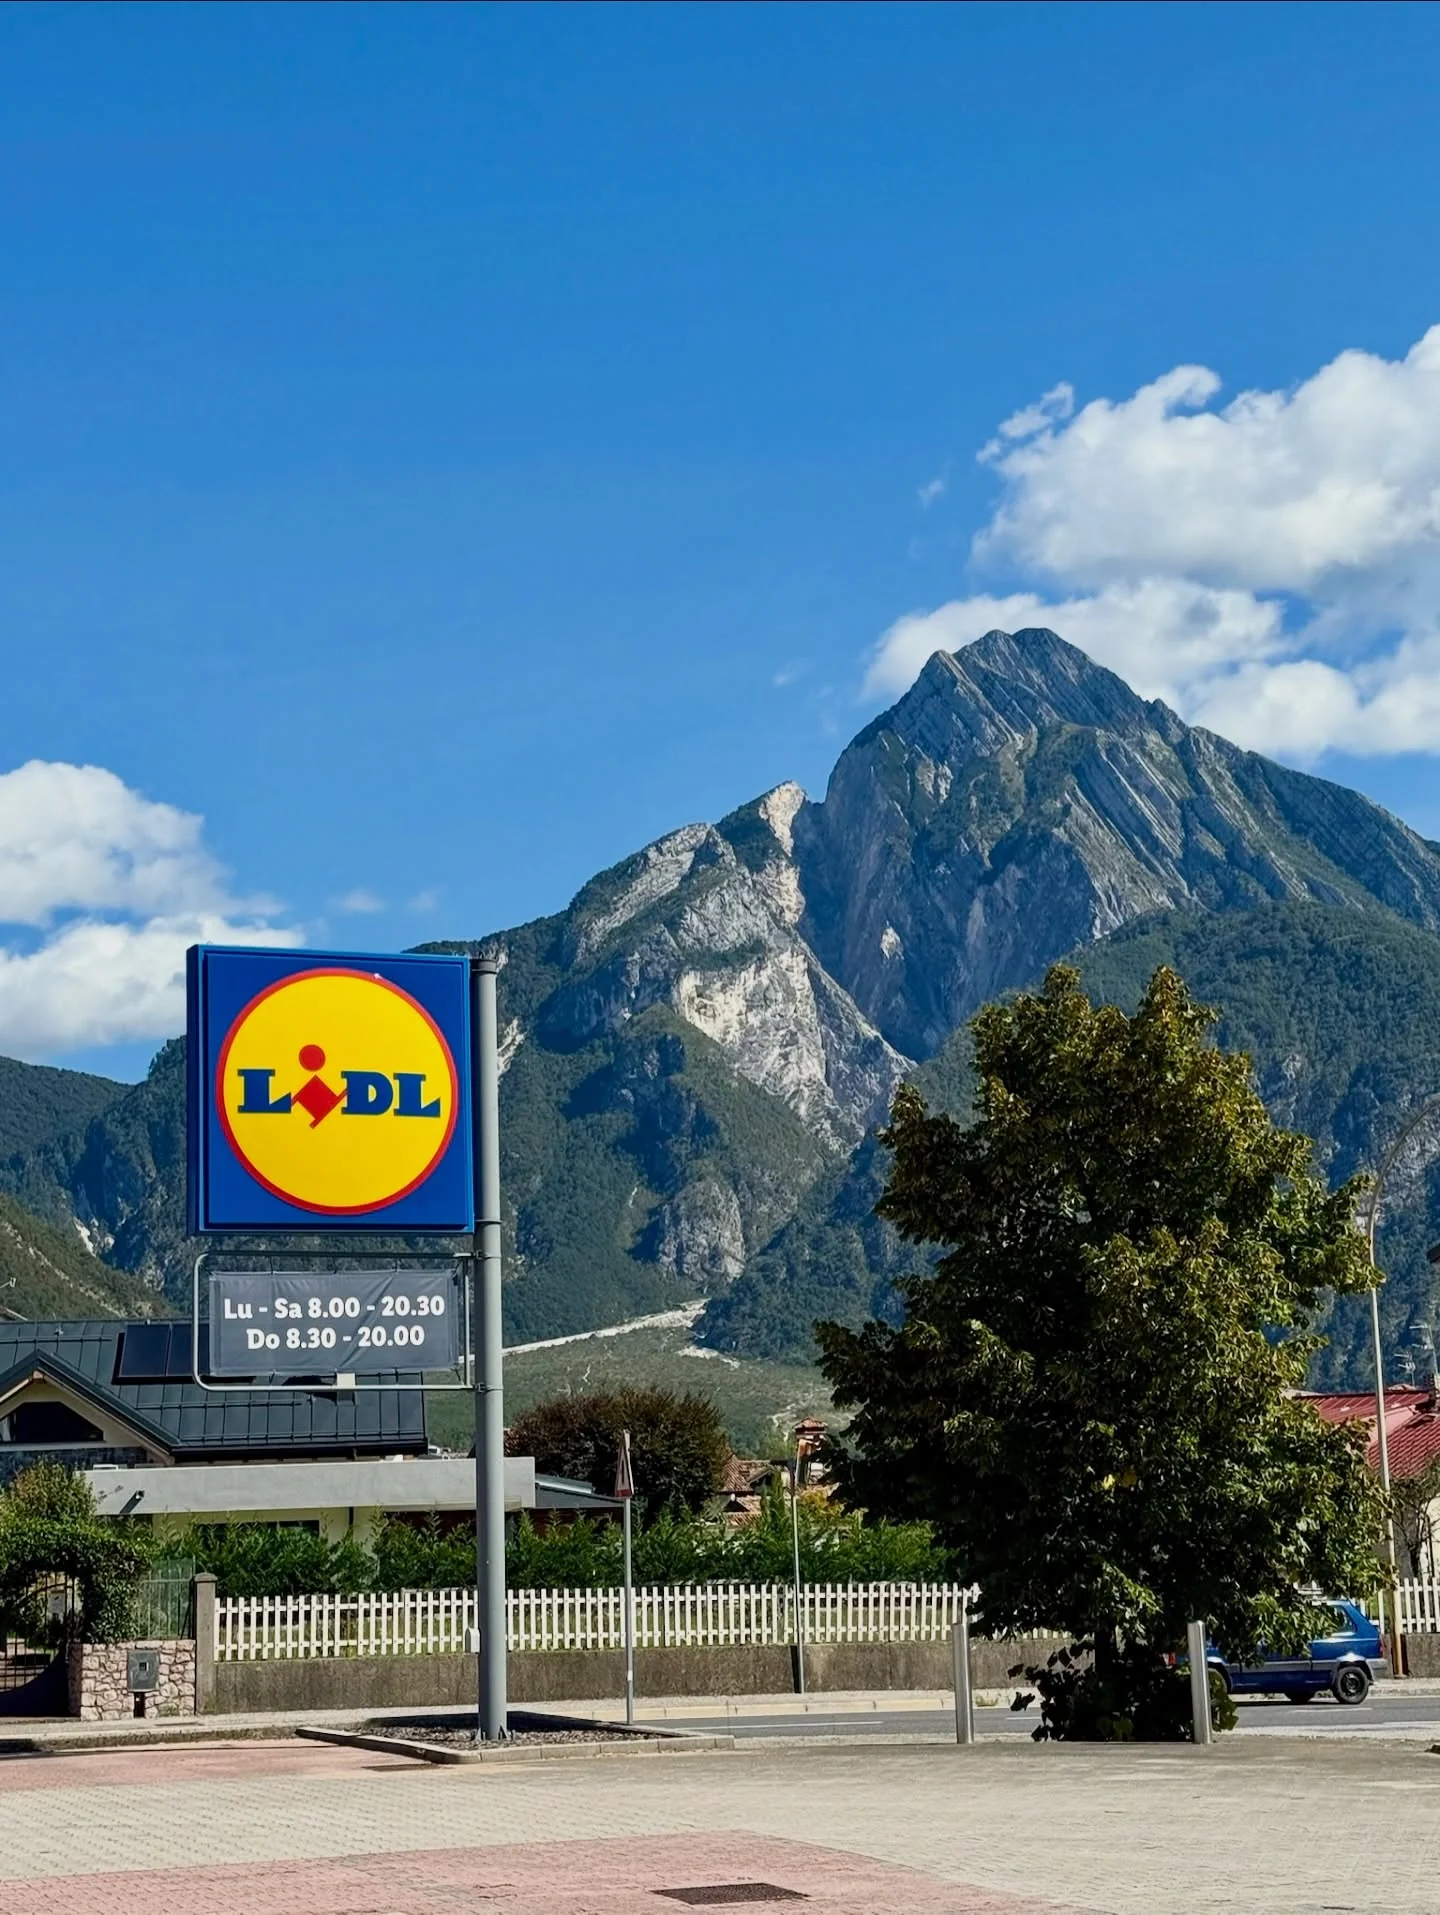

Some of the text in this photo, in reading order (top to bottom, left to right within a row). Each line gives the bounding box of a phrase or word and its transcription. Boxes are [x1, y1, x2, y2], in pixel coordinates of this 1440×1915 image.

[224, 1298, 253, 1320] Lu
[274, 1297, 303, 1319] Sa
[307, 1296, 361, 1319] 8.00
[381, 1295, 445, 1317] 20.30
[246, 1328, 281, 1350] Do
[285, 1327, 337, 1349] 8.30
[357, 1324, 425, 1347] 20.00
